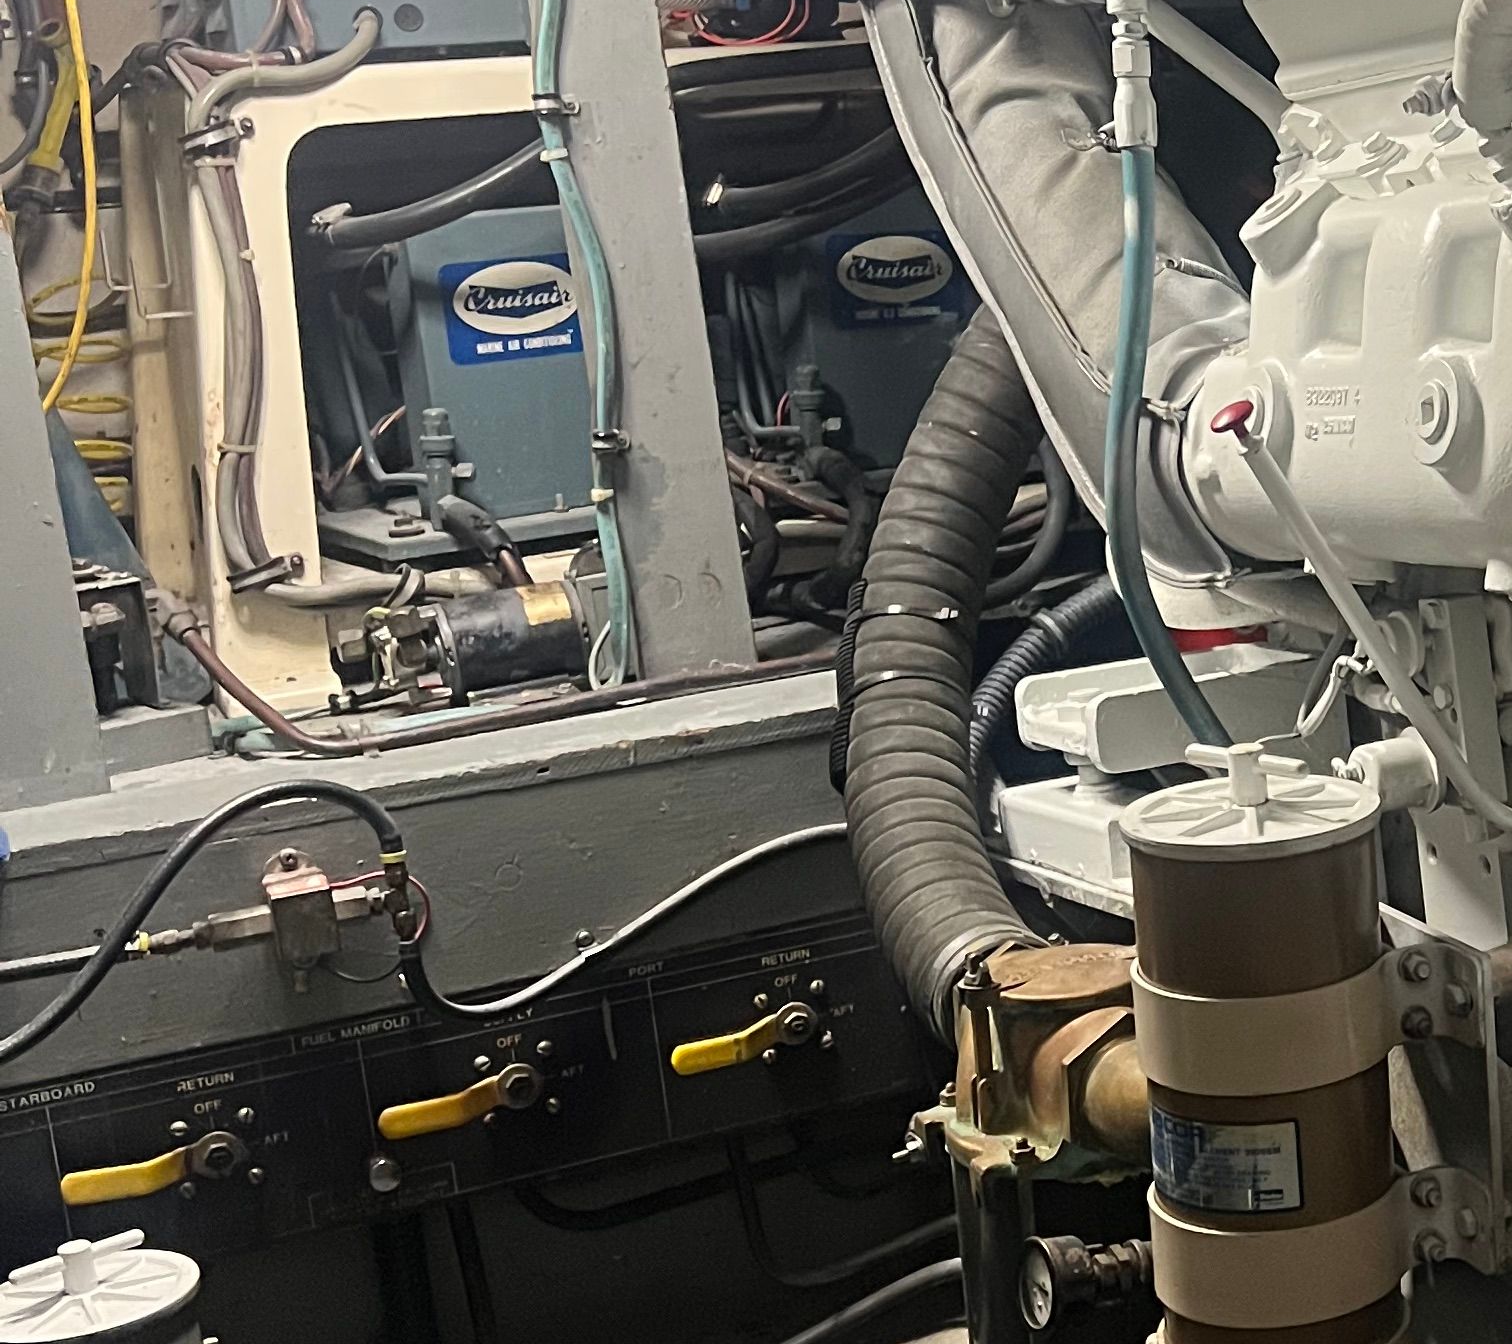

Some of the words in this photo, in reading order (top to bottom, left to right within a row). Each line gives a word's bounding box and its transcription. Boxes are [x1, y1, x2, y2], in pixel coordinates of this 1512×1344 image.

[846, 257, 942, 280] Cruisair
[464, 285, 572, 312] Cruisair
[761, 948, 810, 967] RETURN
[628, 961, 665, 978] PORT
[774, 973, 798, 988] OFF
[301, 1031, 336, 1049] FUEL
[340, 1015, 411, 1039] MANIFOLD
[496, 1033, 522, 1049] OFF
[176, 1071, 235, 1093] RETURN
[0, 1080, 96, 1112] STARBOARD
[193, 1098, 222, 1114] OFF
